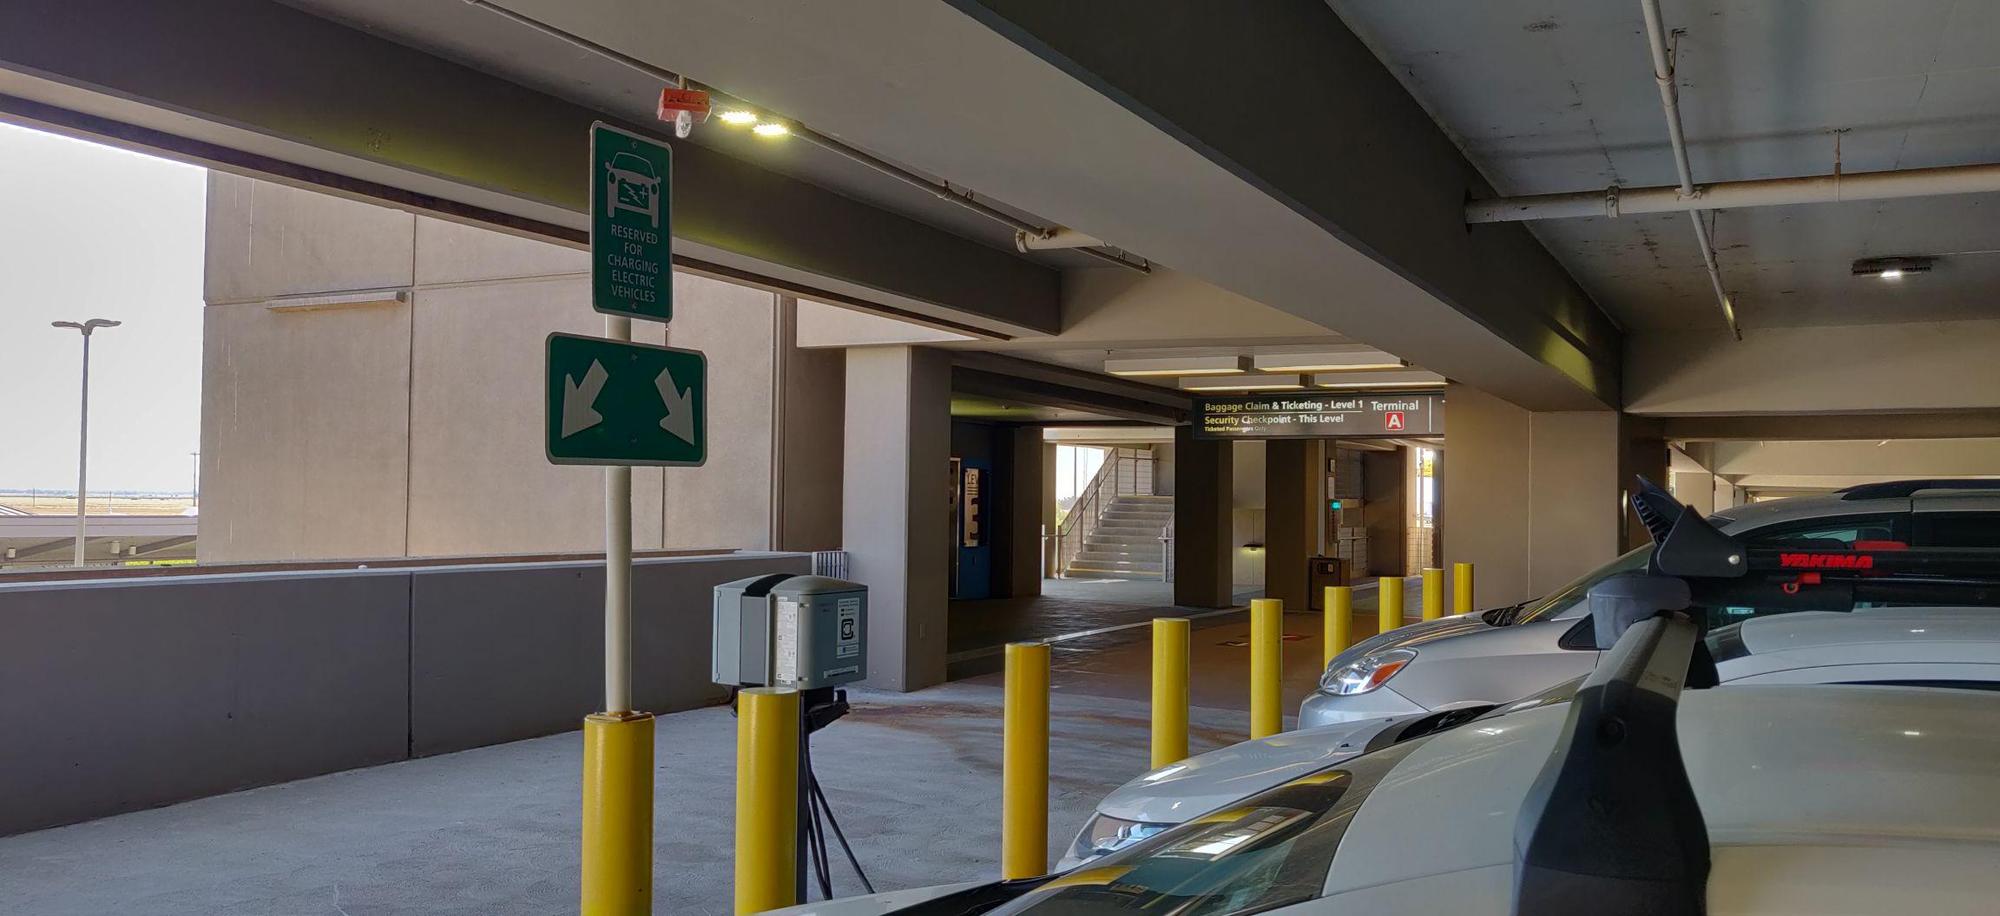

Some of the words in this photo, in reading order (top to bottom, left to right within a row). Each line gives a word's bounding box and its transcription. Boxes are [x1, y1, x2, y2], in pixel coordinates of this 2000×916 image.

[611, 223, 658, 244] RESERVED
[624, 242, 643, 256] FOR
[607, 253, 659, 274] CHARGING
[612, 269, 655, 288] ELECTRIC
[611, 284, 656, 303] VEHICLES
[1205, 403, 1243, 412] Baggage
[1245, 402, 1270, 410] Claim
[1272, 402, 1280, 410] &
[1281, 401, 1322, 411] Ticketing
[1331, 400, 1355, 409] Level
[1358, 400, 1363, 408] 1
[1370, 400, 1419, 411] Terminal
[1204, 416, 1239, 425] Security
[1241, 415, 1291, 425] Checkpoint
[1299, 414, 1318, 423] This
[1319, 414, 1344, 423] Level
[1388, 414, 1402, 428] A
[1779, 553, 1873, 569] YAKIMA
